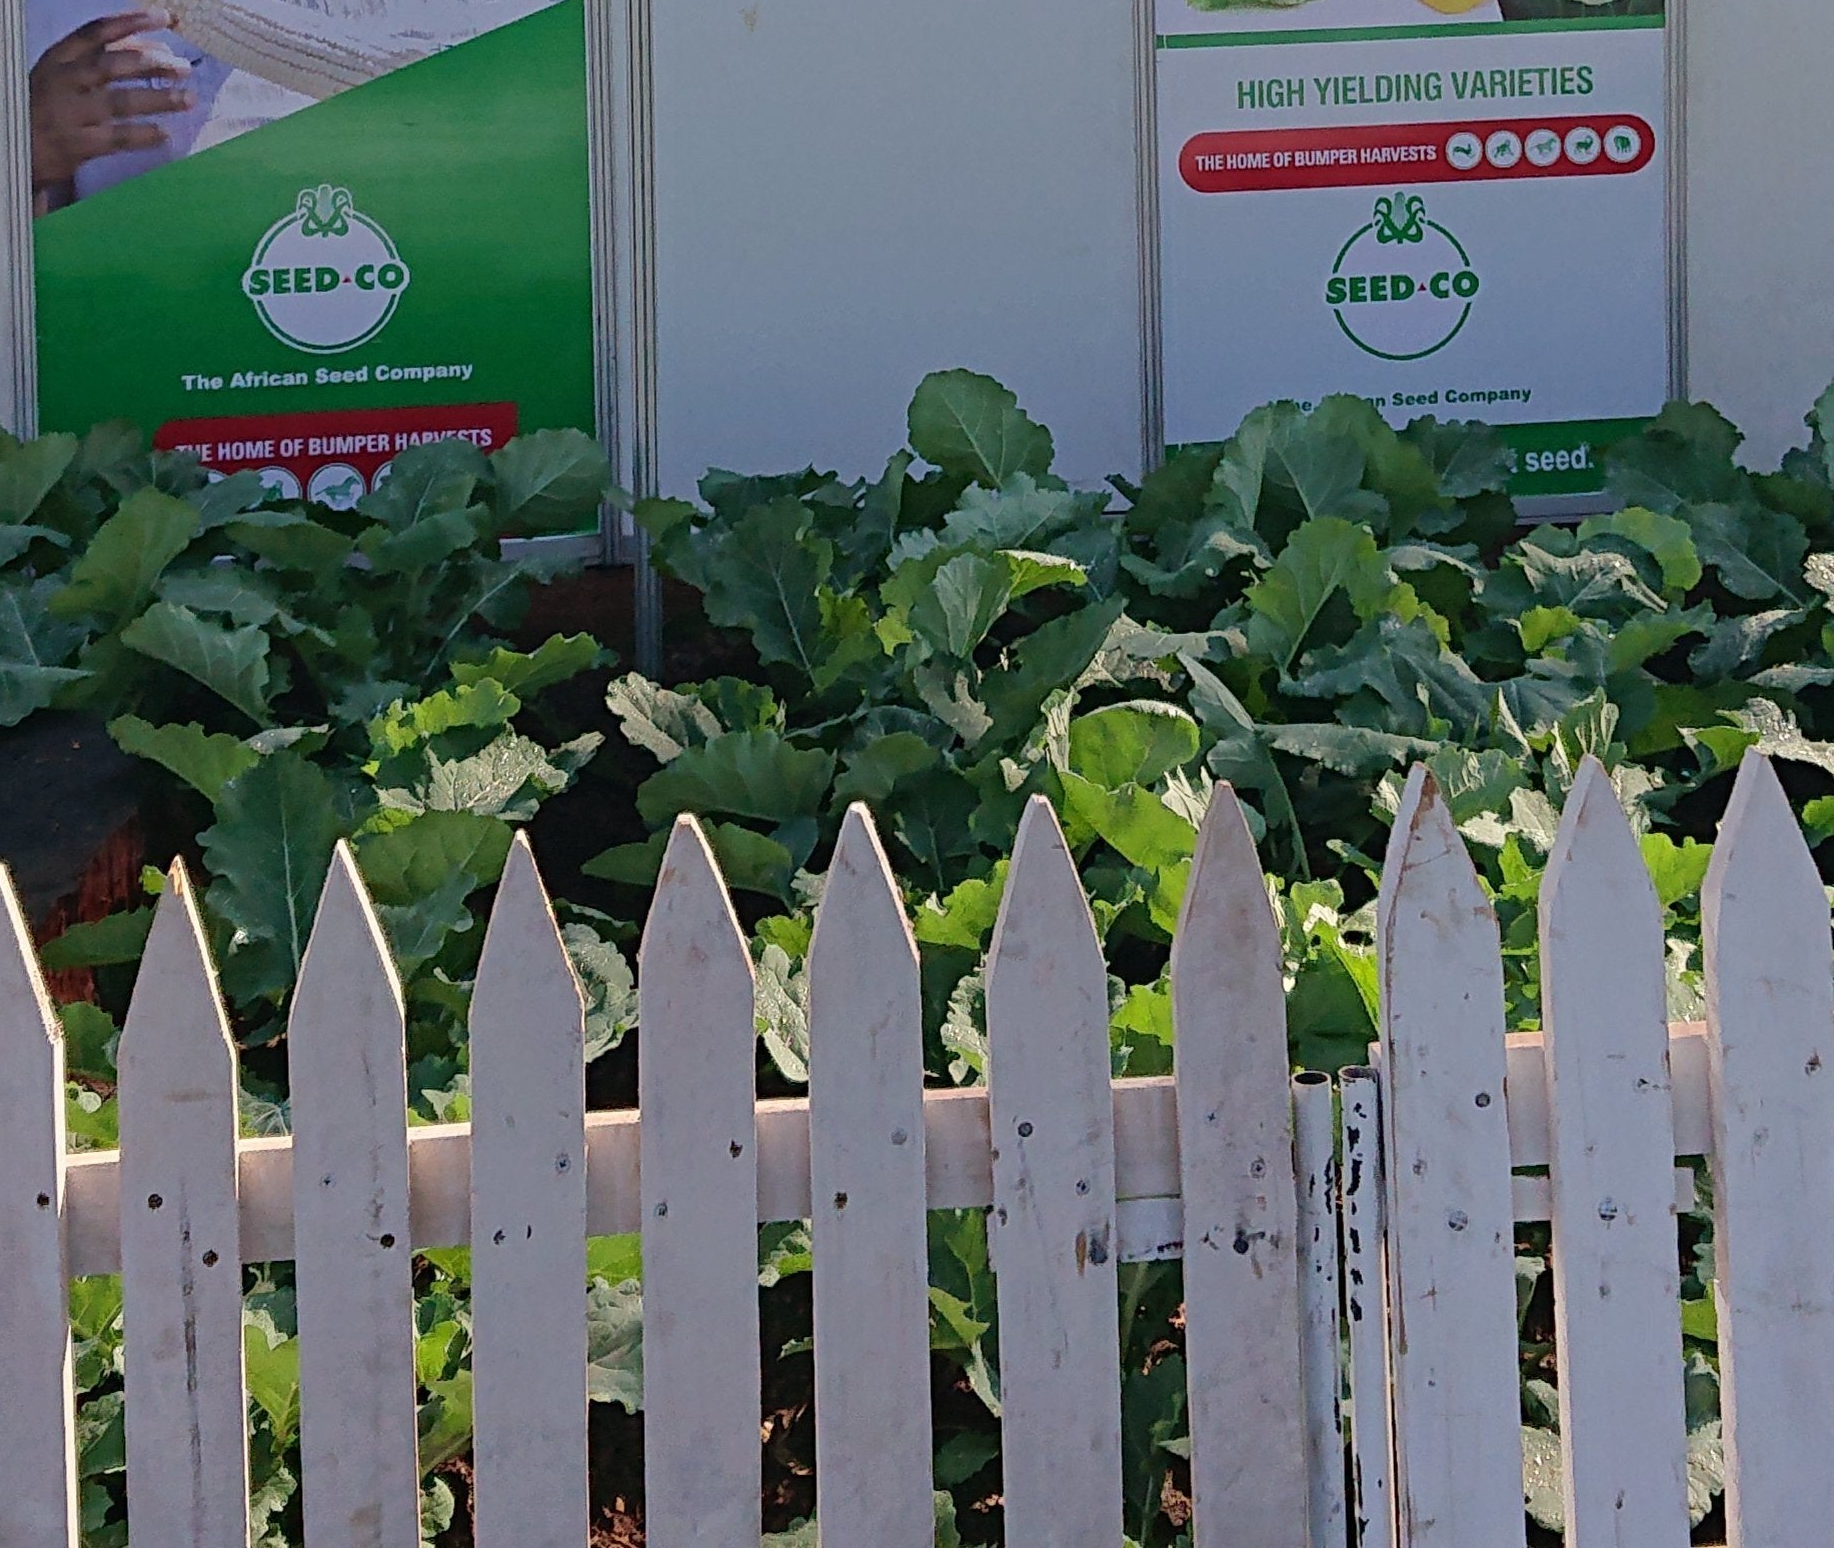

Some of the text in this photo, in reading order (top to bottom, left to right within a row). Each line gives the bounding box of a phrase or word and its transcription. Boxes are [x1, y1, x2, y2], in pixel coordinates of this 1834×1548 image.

[1237, 66, 1593, 109] HIGH YIELDING VARIETIES
[1196, 144, 1437, 172] THE HOME OF BUMPER HARVESTS
[248, 264, 404, 295] SEED CO
[1326, 271, 1480, 304] SEED CO
[181, 363, 473, 391] The African Seed Company
[1392, 391, 1438, 406] Seed
[1445, 388, 1531, 403] Company
[218, 440, 275, 461] HOME
[280, 438, 303, 457] OF
[308, 434, 390, 455] BUMPER
[1525, 442, 1594, 472] seed.
